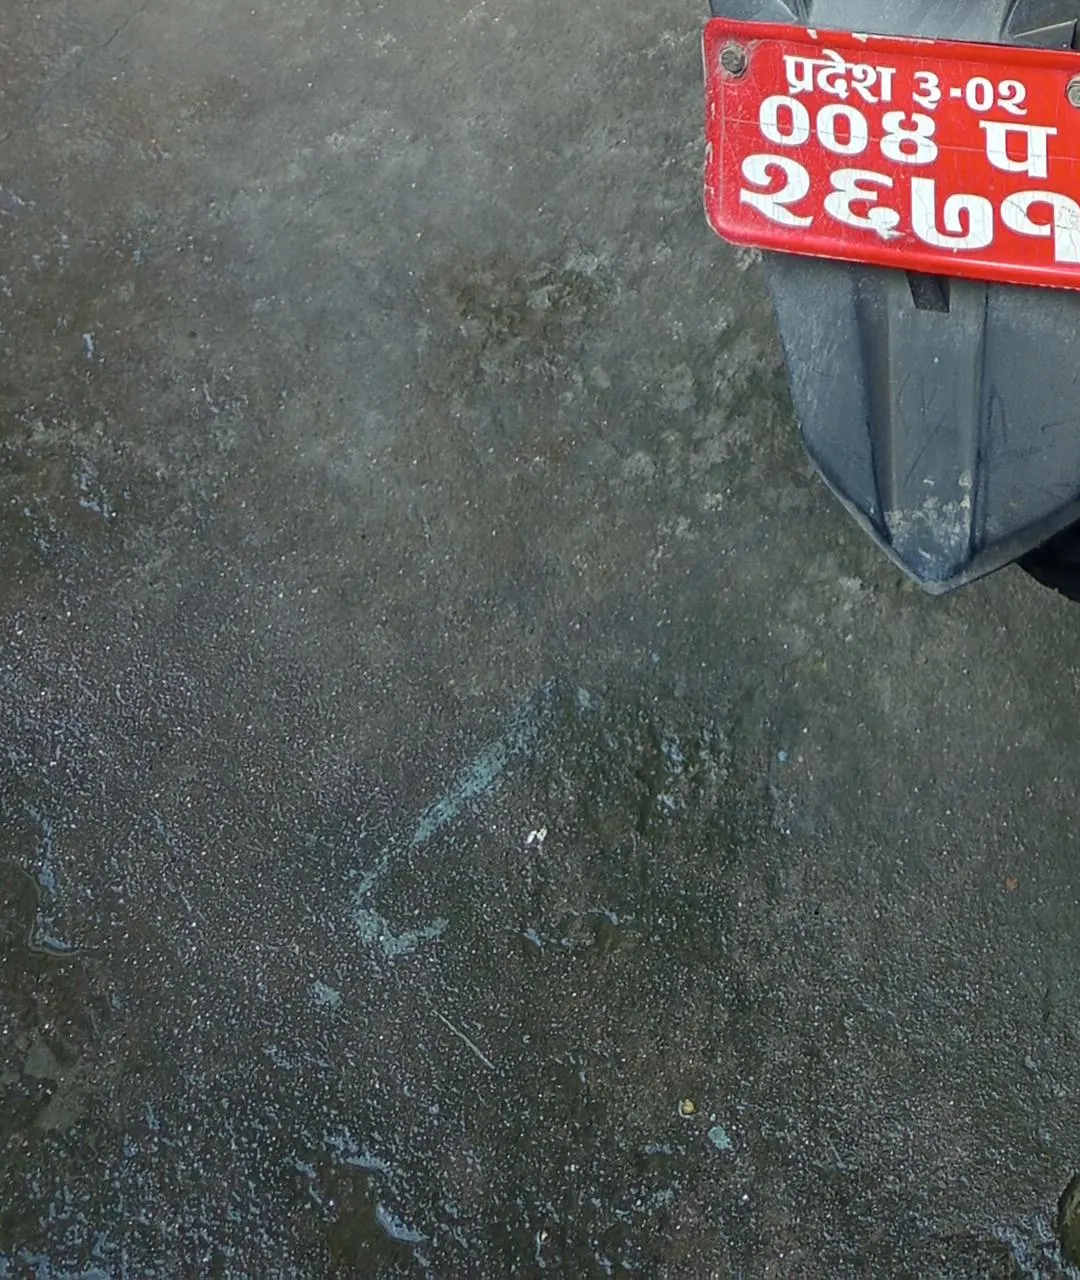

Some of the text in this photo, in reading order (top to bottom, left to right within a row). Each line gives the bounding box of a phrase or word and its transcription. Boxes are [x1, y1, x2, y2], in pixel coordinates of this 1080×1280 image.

[783, 49, 896, 103] प्रदेश
[758, 95, 1058, 179] ००४ प
